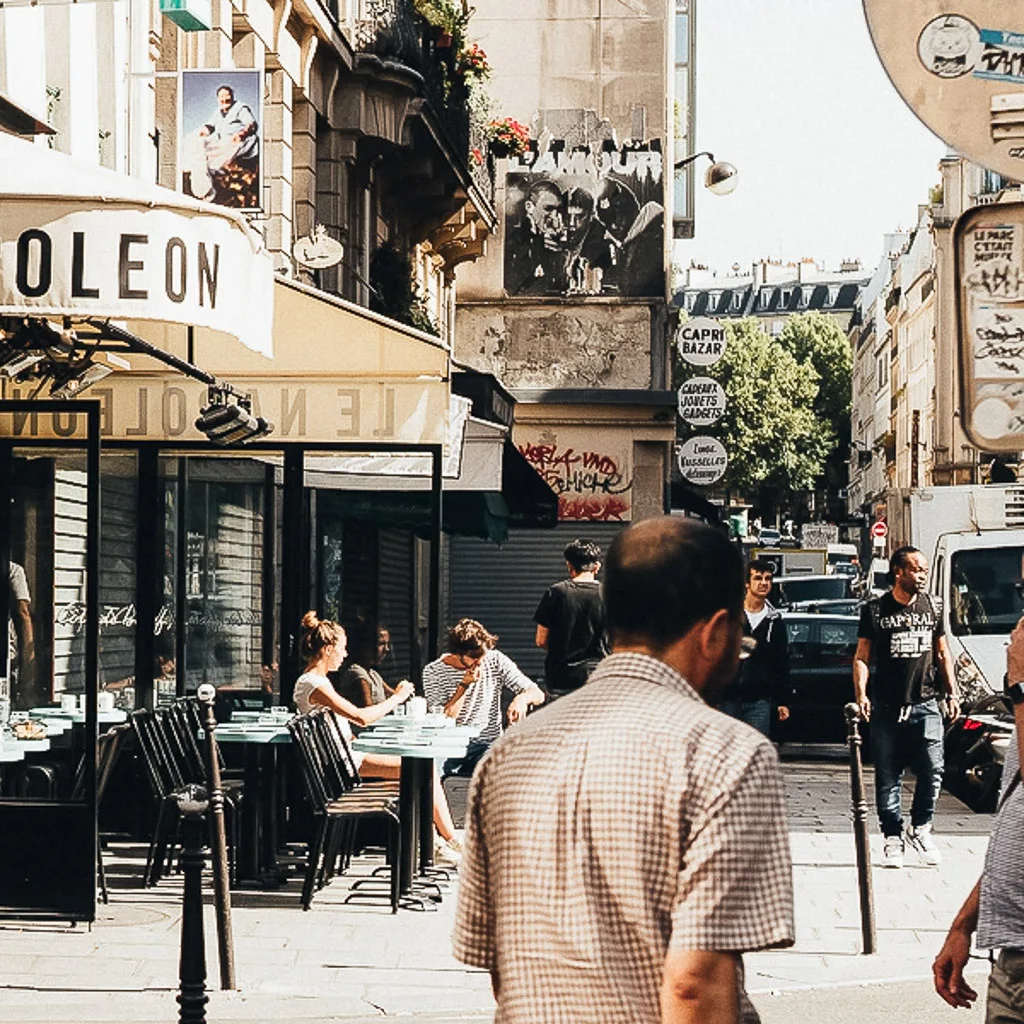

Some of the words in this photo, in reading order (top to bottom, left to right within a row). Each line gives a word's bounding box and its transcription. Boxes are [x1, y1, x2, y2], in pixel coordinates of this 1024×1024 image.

[682, 328, 724, 342] CAPRI
[682, 342, 722, 355] BAZAR
[681, 383, 718, 395] CADEAUX
[681, 395, 718, 407] JOUETS
[682, 407, 723, 419] GADGETS
